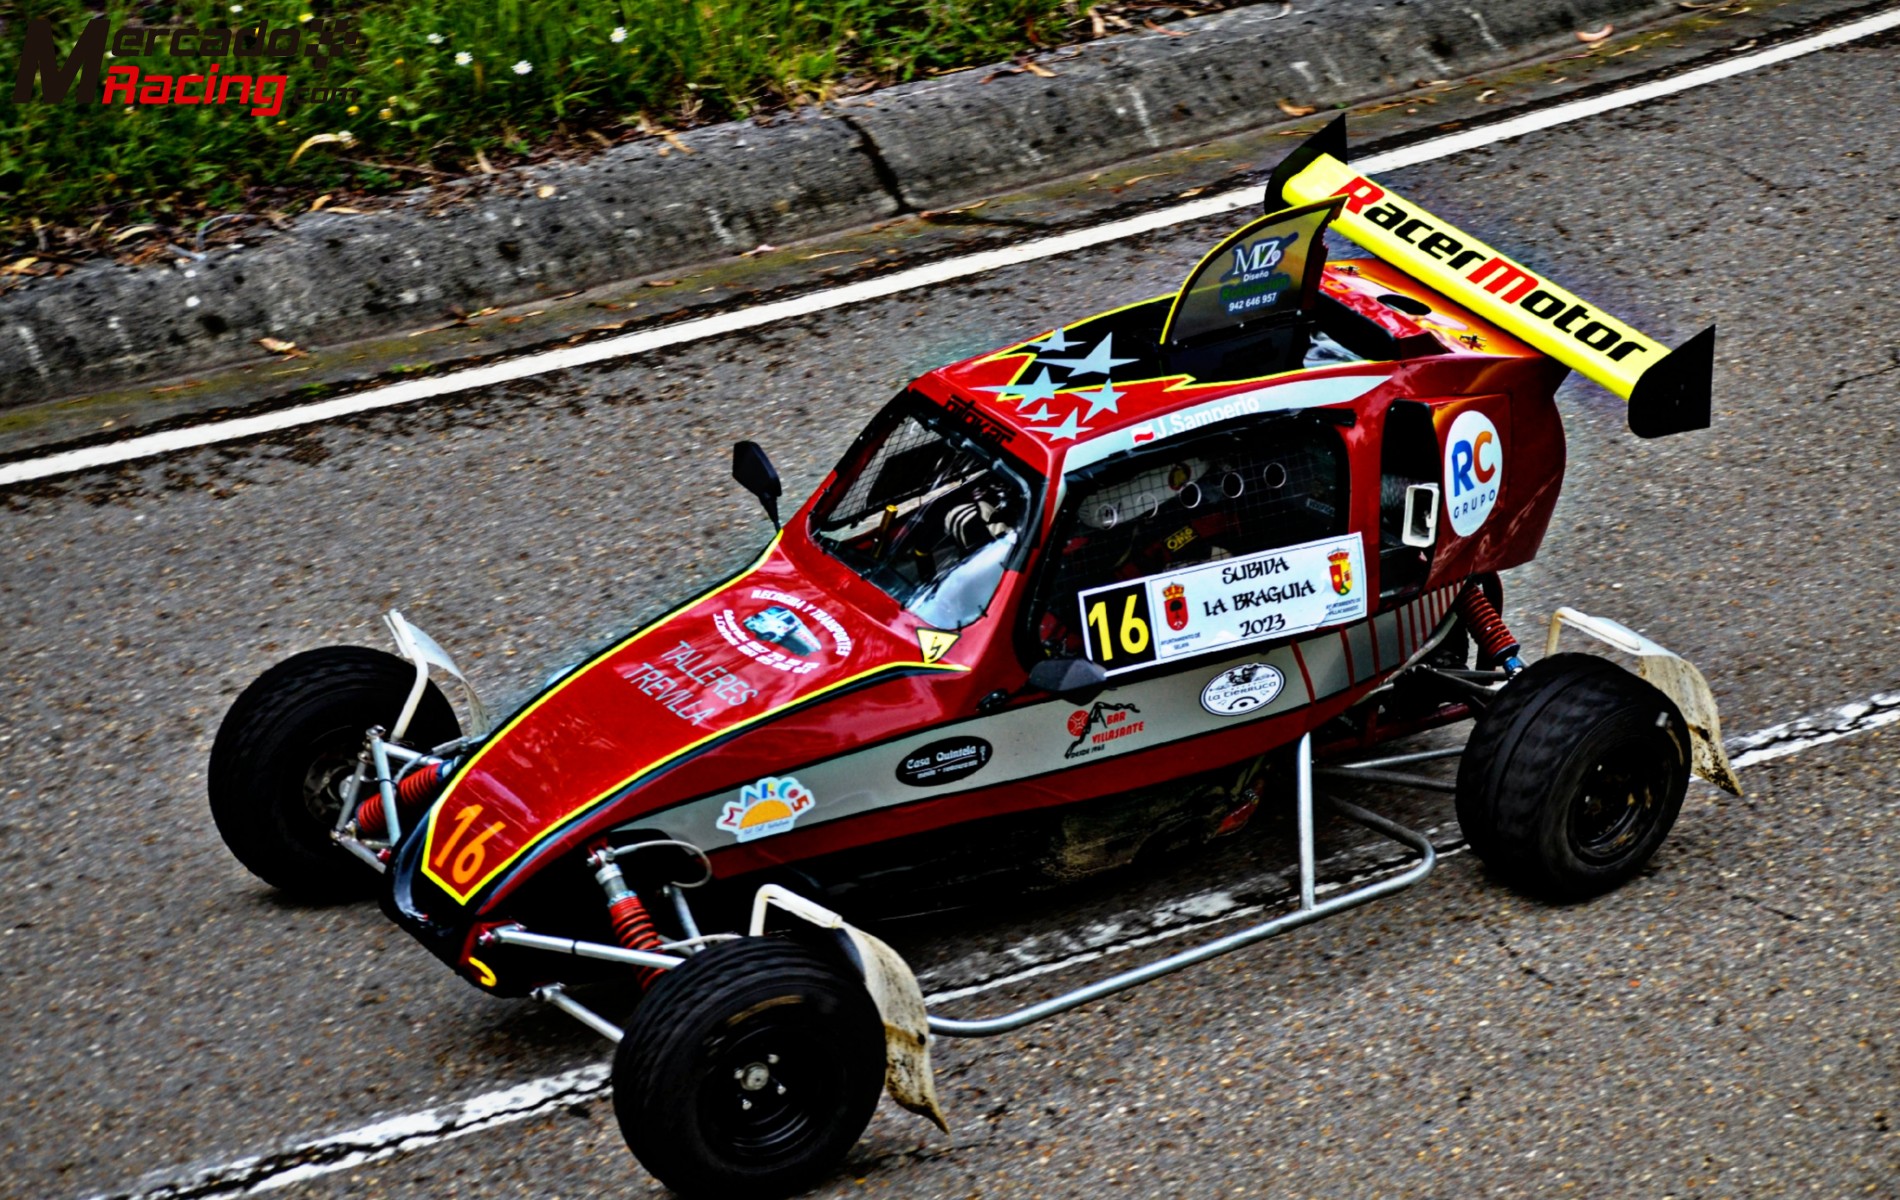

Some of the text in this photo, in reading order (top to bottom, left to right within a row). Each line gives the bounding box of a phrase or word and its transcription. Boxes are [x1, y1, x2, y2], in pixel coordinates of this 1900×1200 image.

[1228, 292, 1277, 312] 942 646 957
[1451, 430, 1496, 497] RC
[1453, 489, 1496, 519] GRUPO
[1222, 556, 1290, 585] SUBIDA
[1203, 580, 1317, 618] LA BRAGUIA
[1088, 594, 1149, 661] 16
[1239, 613, 1287, 638] 2023
[661, 640, 760, 707] TALLERES
[623, 661, 716, 726] TREVILLA
[1092, 721, 1144, 744] VILLASANTE
[1106, 711, 1126, 726] BAR
[906, 757, 930, 769] Casa
[434, 804, 507, 885] 16
